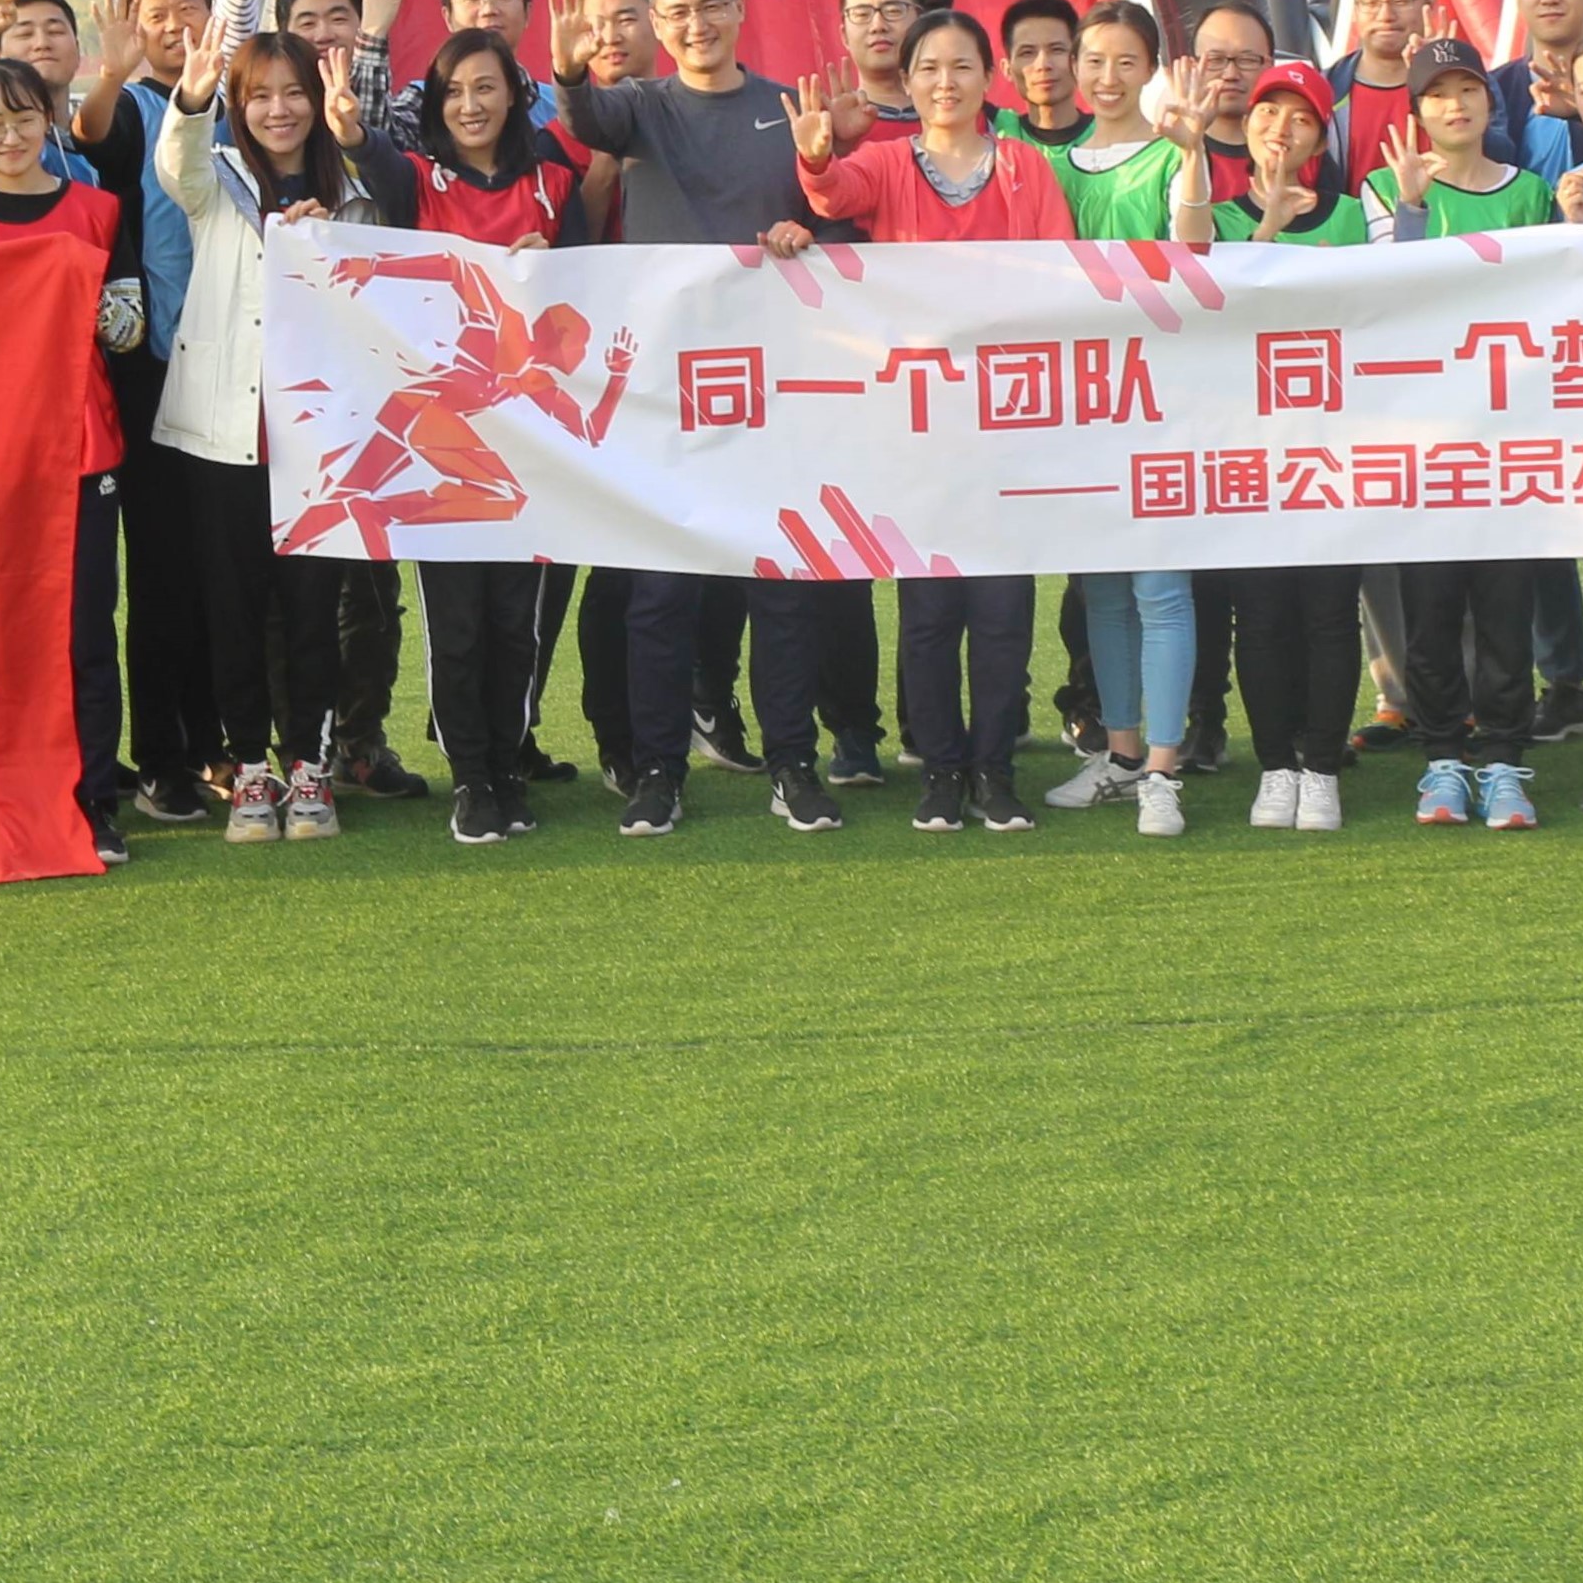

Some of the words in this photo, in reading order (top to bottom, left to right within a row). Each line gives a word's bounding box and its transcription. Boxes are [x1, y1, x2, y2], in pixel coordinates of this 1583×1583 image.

[678, 336, 1164, 433] 同一个团队
